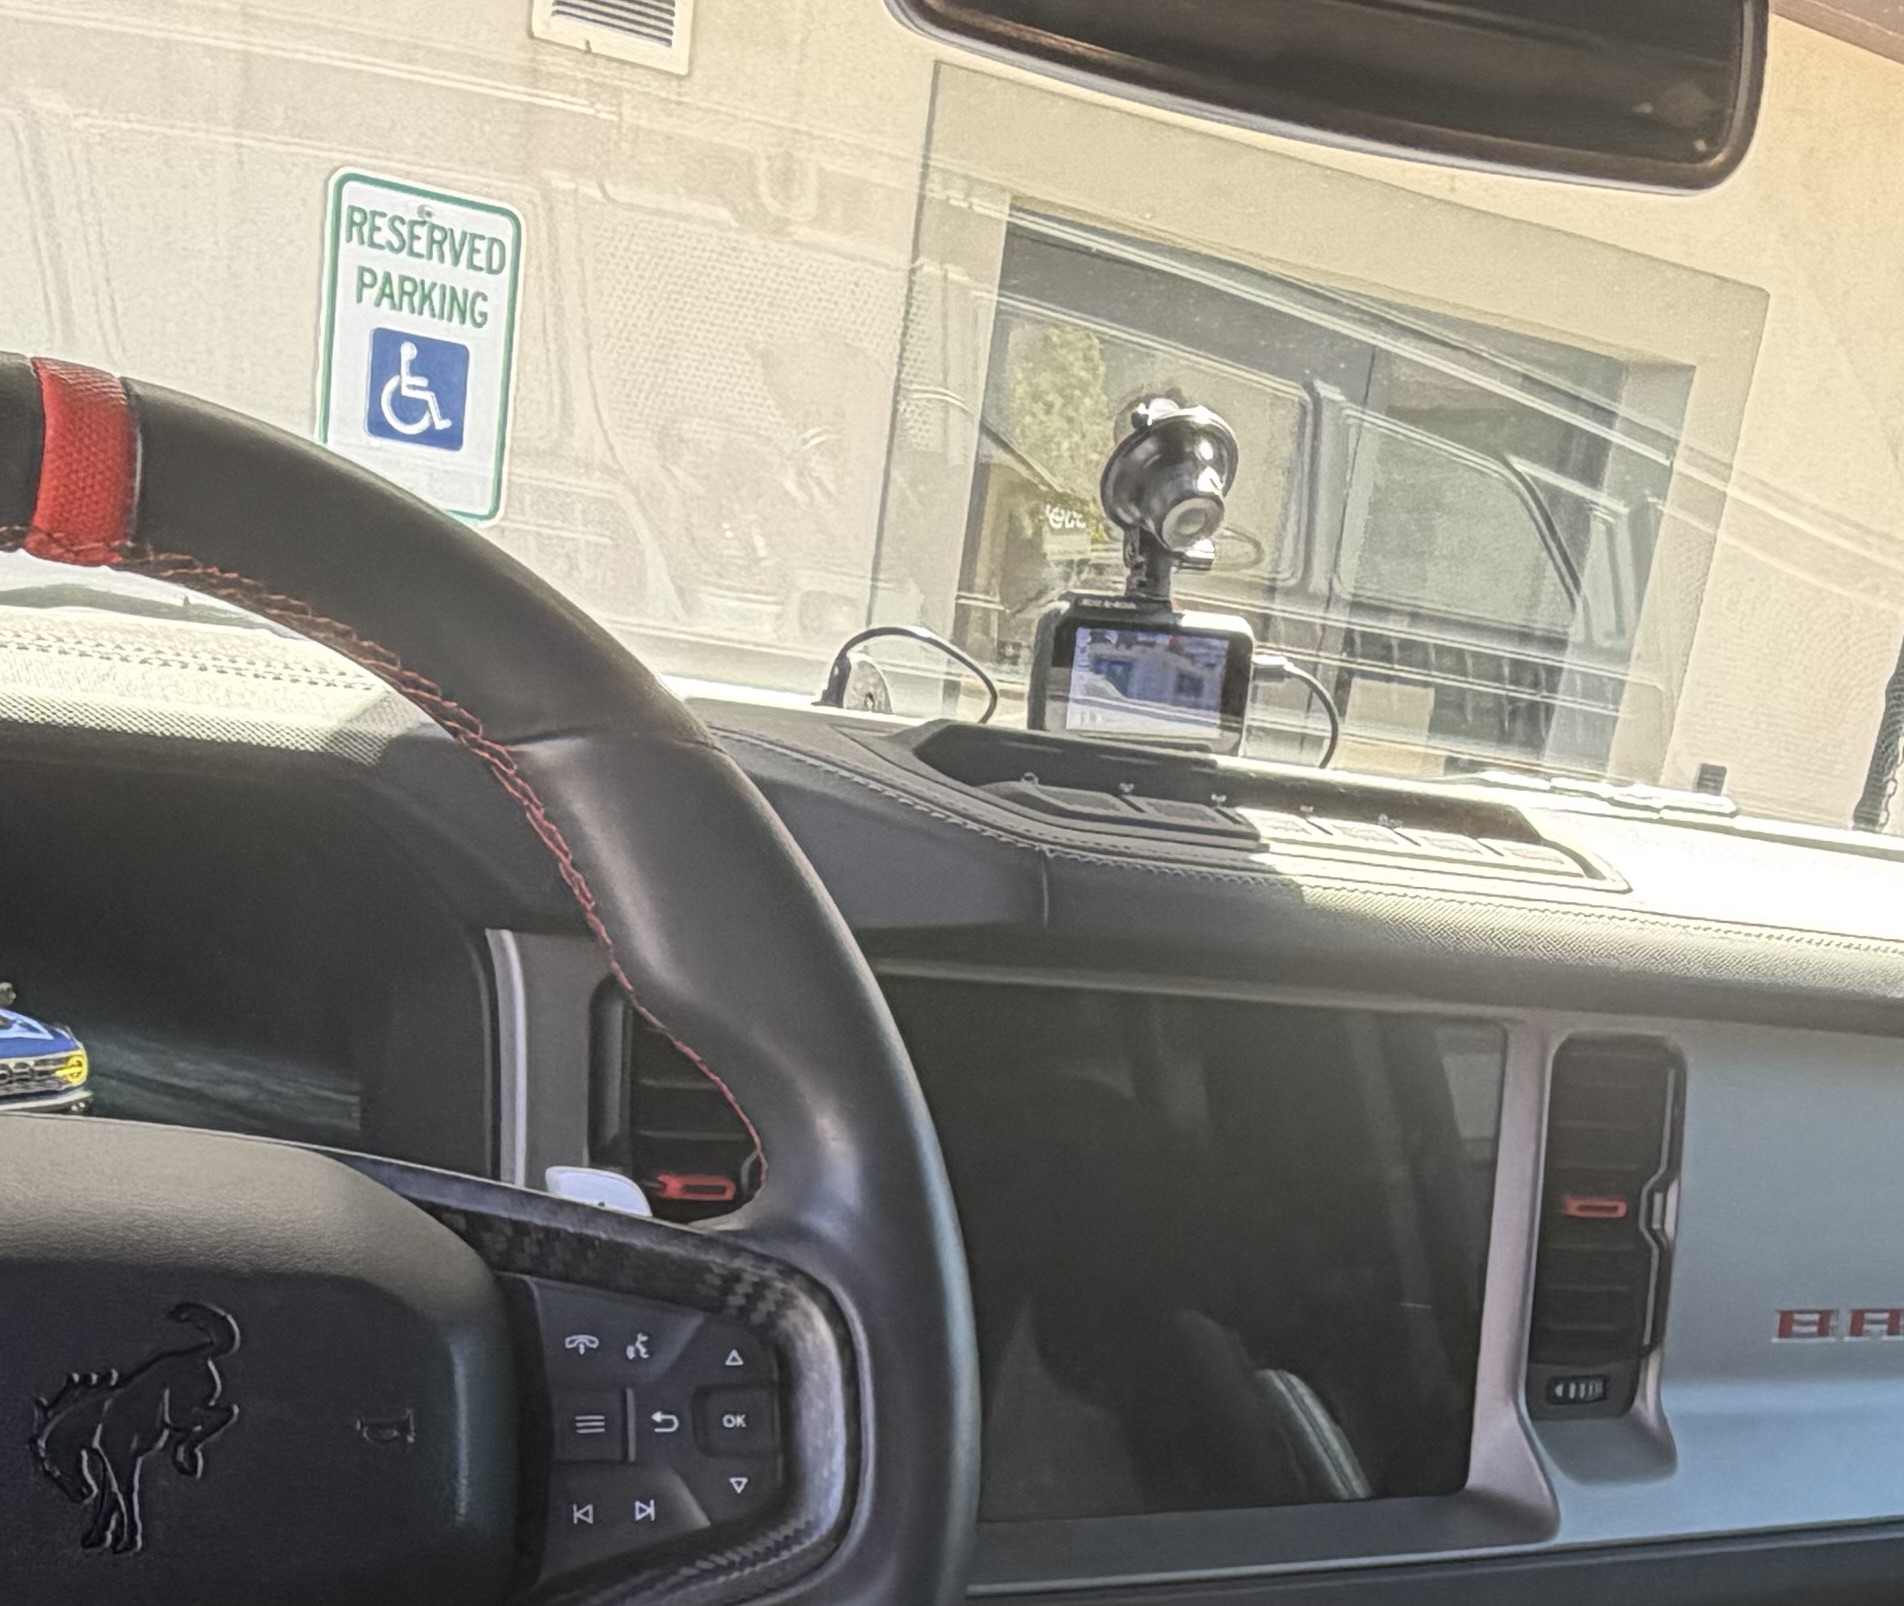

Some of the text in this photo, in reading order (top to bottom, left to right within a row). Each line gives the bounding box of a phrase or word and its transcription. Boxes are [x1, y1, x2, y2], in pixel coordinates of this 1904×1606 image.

[345, 204, 507, 276] RESERVED
[355, 265, 489, 329] PARKING
[722, 1414, 747, 1428] OK
